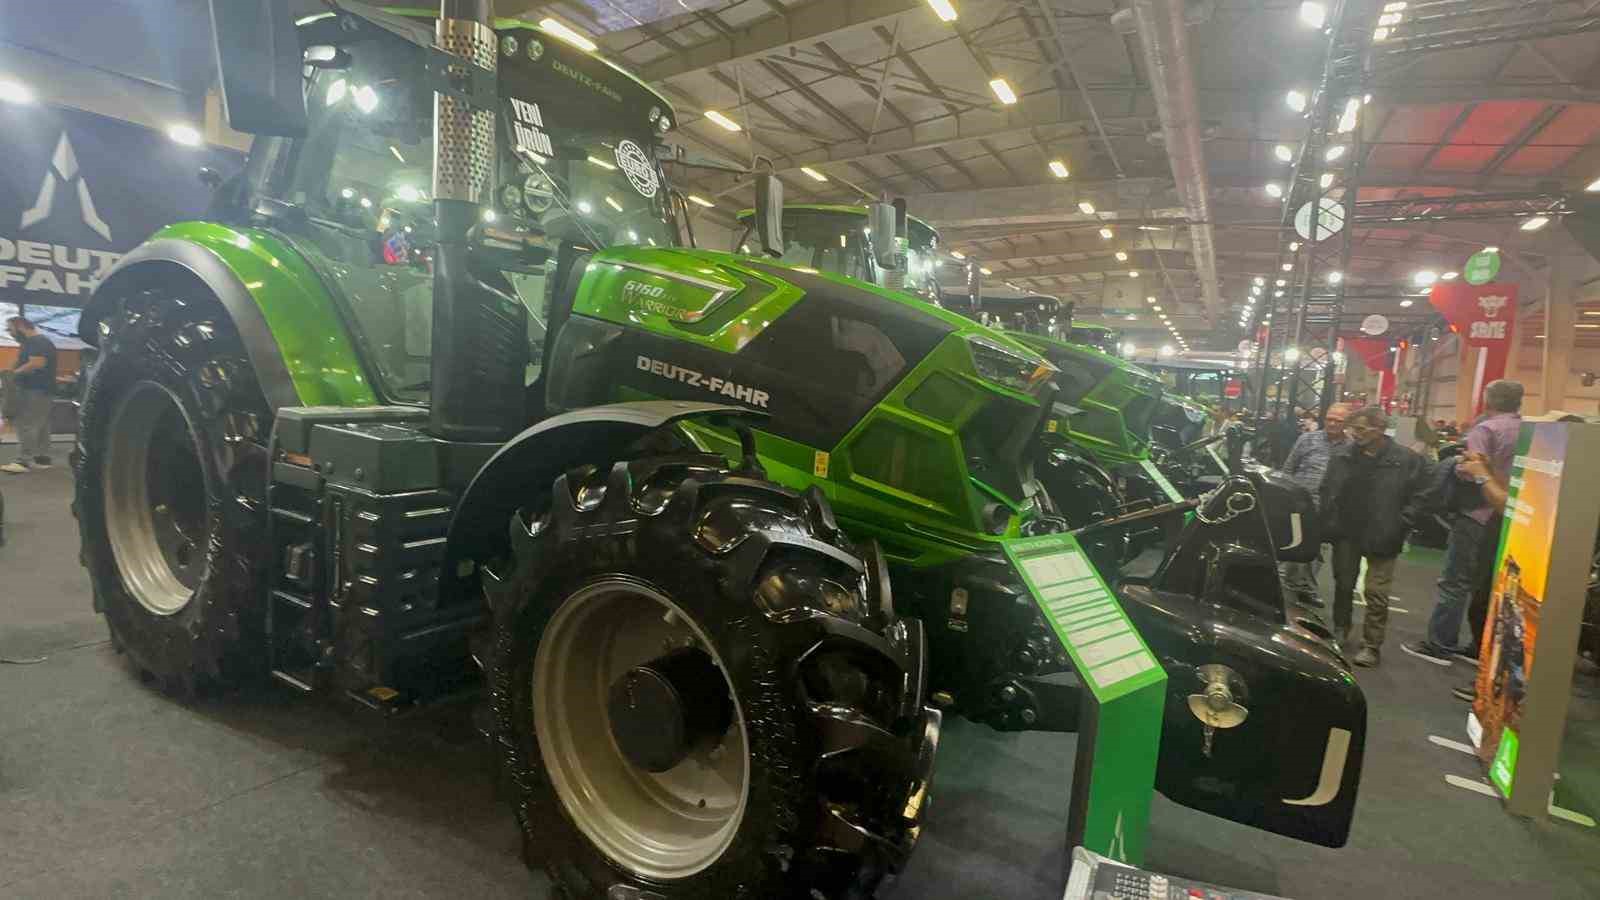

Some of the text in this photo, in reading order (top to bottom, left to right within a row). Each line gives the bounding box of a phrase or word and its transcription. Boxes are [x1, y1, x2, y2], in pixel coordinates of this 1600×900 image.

[0, 237, 122, 277] DEUT
[0, 265, 98, 295] FAH
[624, 280, 664, 298] 6160
[636, 355, 770, 408] DEUTZ-FAHR
